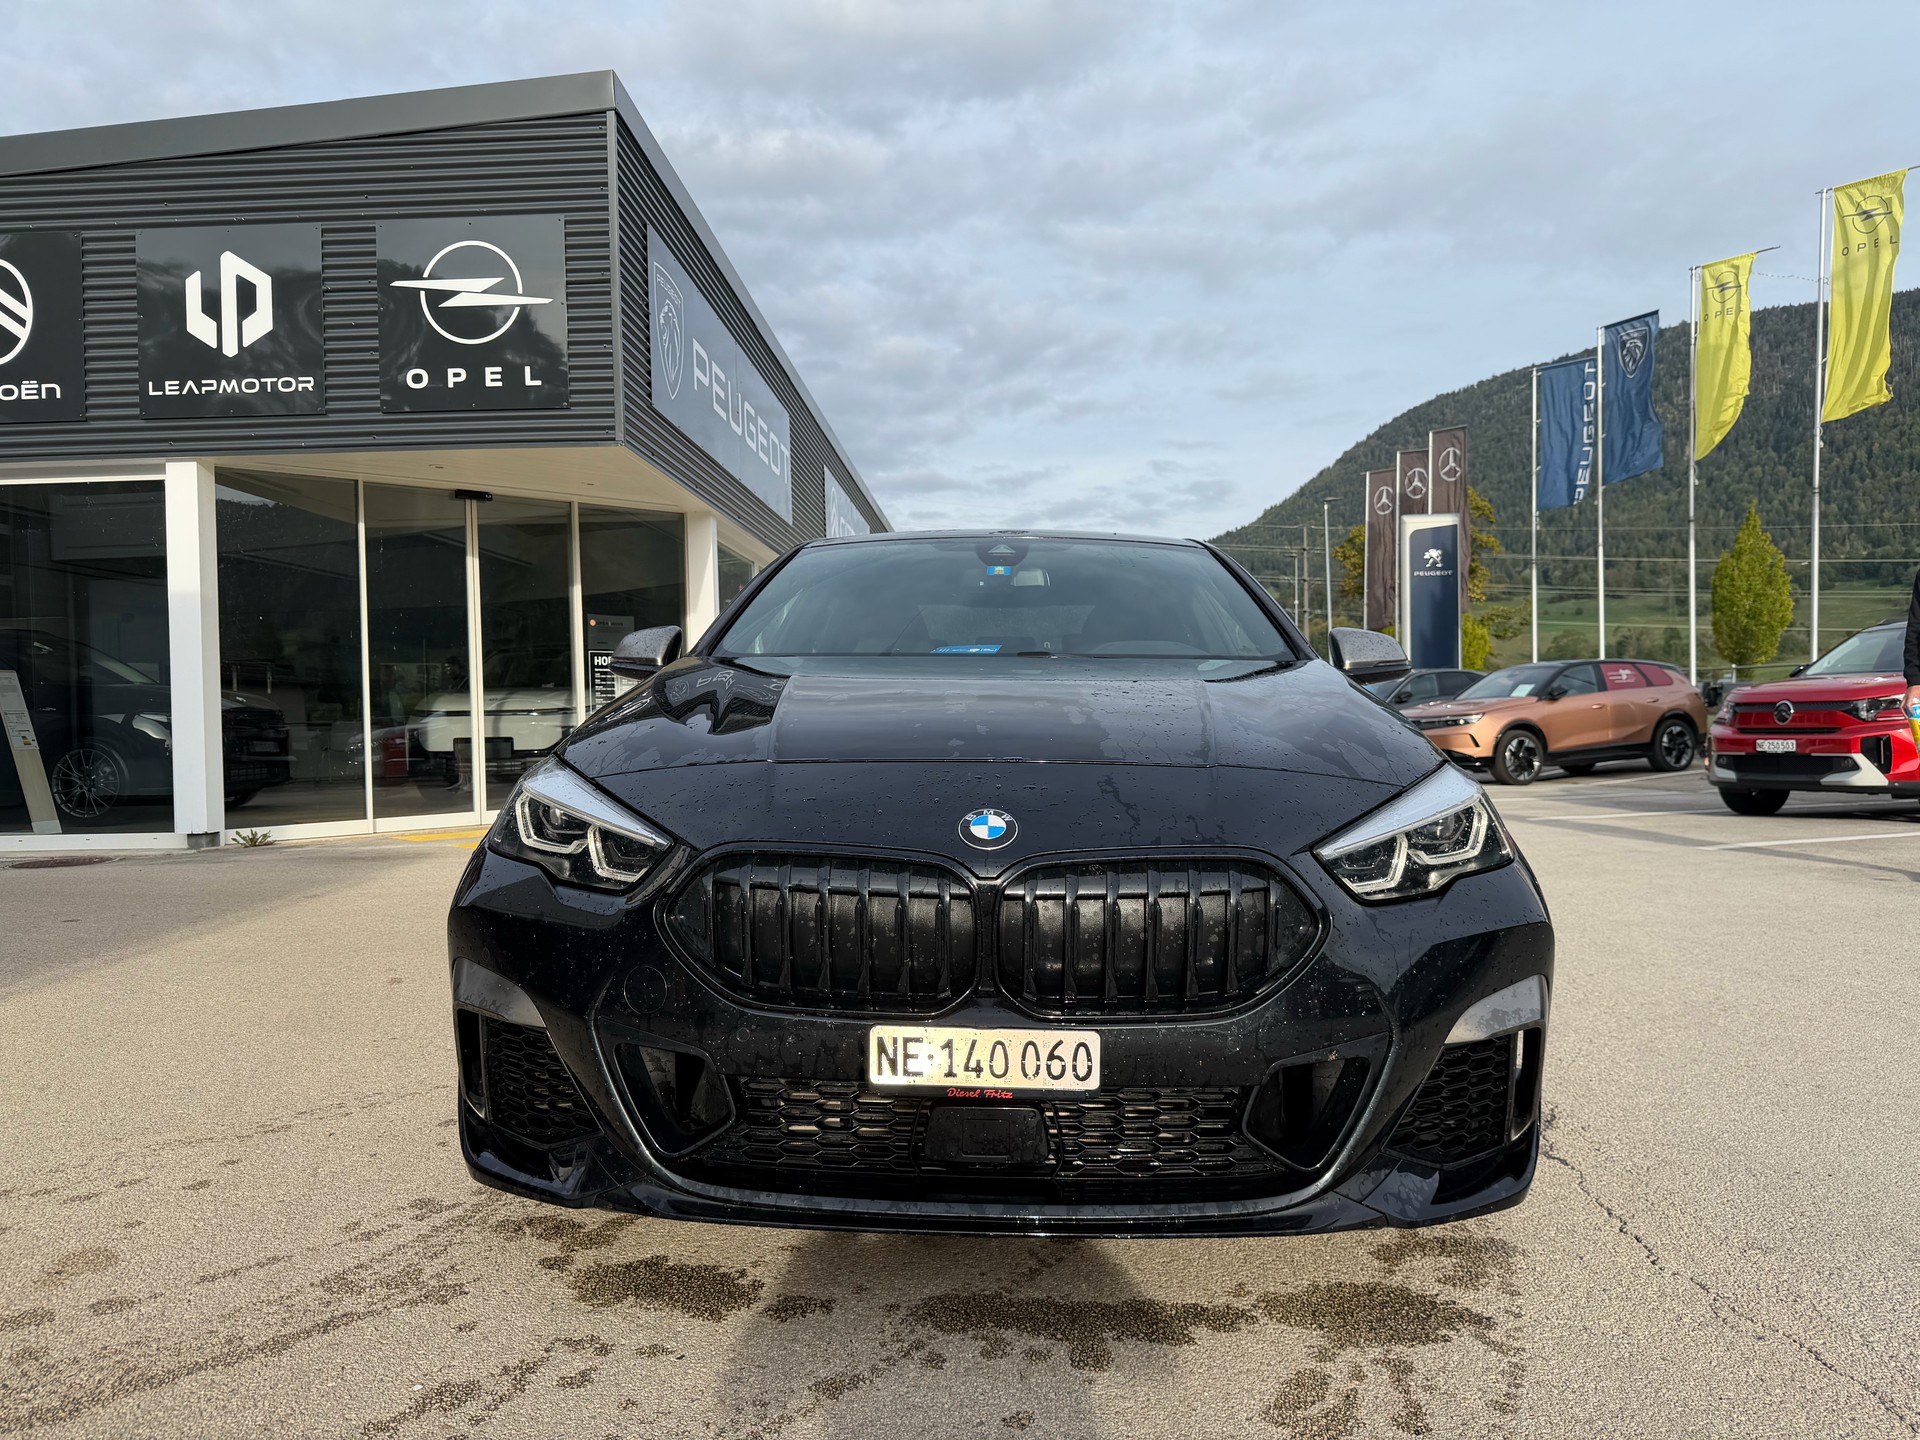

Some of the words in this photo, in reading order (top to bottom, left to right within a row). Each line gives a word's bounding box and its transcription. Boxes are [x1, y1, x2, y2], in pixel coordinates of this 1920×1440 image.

[1841, 235, 1898, 257] OPEL
[148, 376, 315, 396] LEAPMOTOR
[405, 365, 543, 390] OPEL
[692, 337, 789, 485] PEUGEOT
[1413, 569, 1453, 577] PEUGEOT
[965, 809, 1013, 822] BMW
[946, 1087, 981, 1098] Diesel
[983, 1089, 1013, 1099] Fritz
